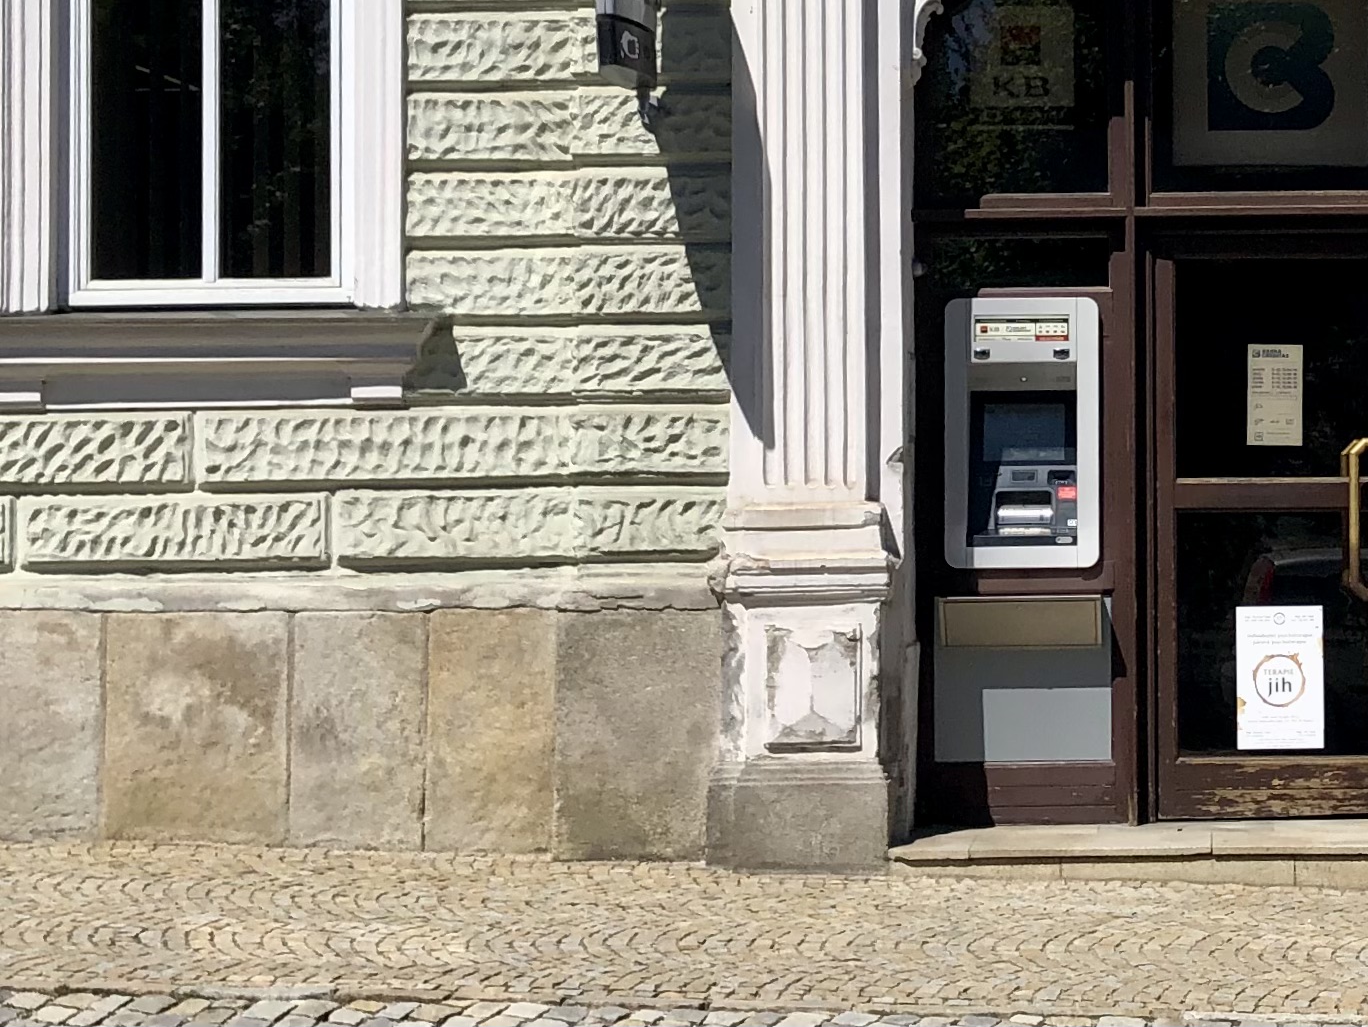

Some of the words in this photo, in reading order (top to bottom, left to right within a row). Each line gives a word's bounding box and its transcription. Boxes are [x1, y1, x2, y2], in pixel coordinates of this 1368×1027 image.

[993, 76, 1050, 97] KB
[1263, 668, 1294, 676] TERAPIE
[1267, 676, 1292, 698] jih
